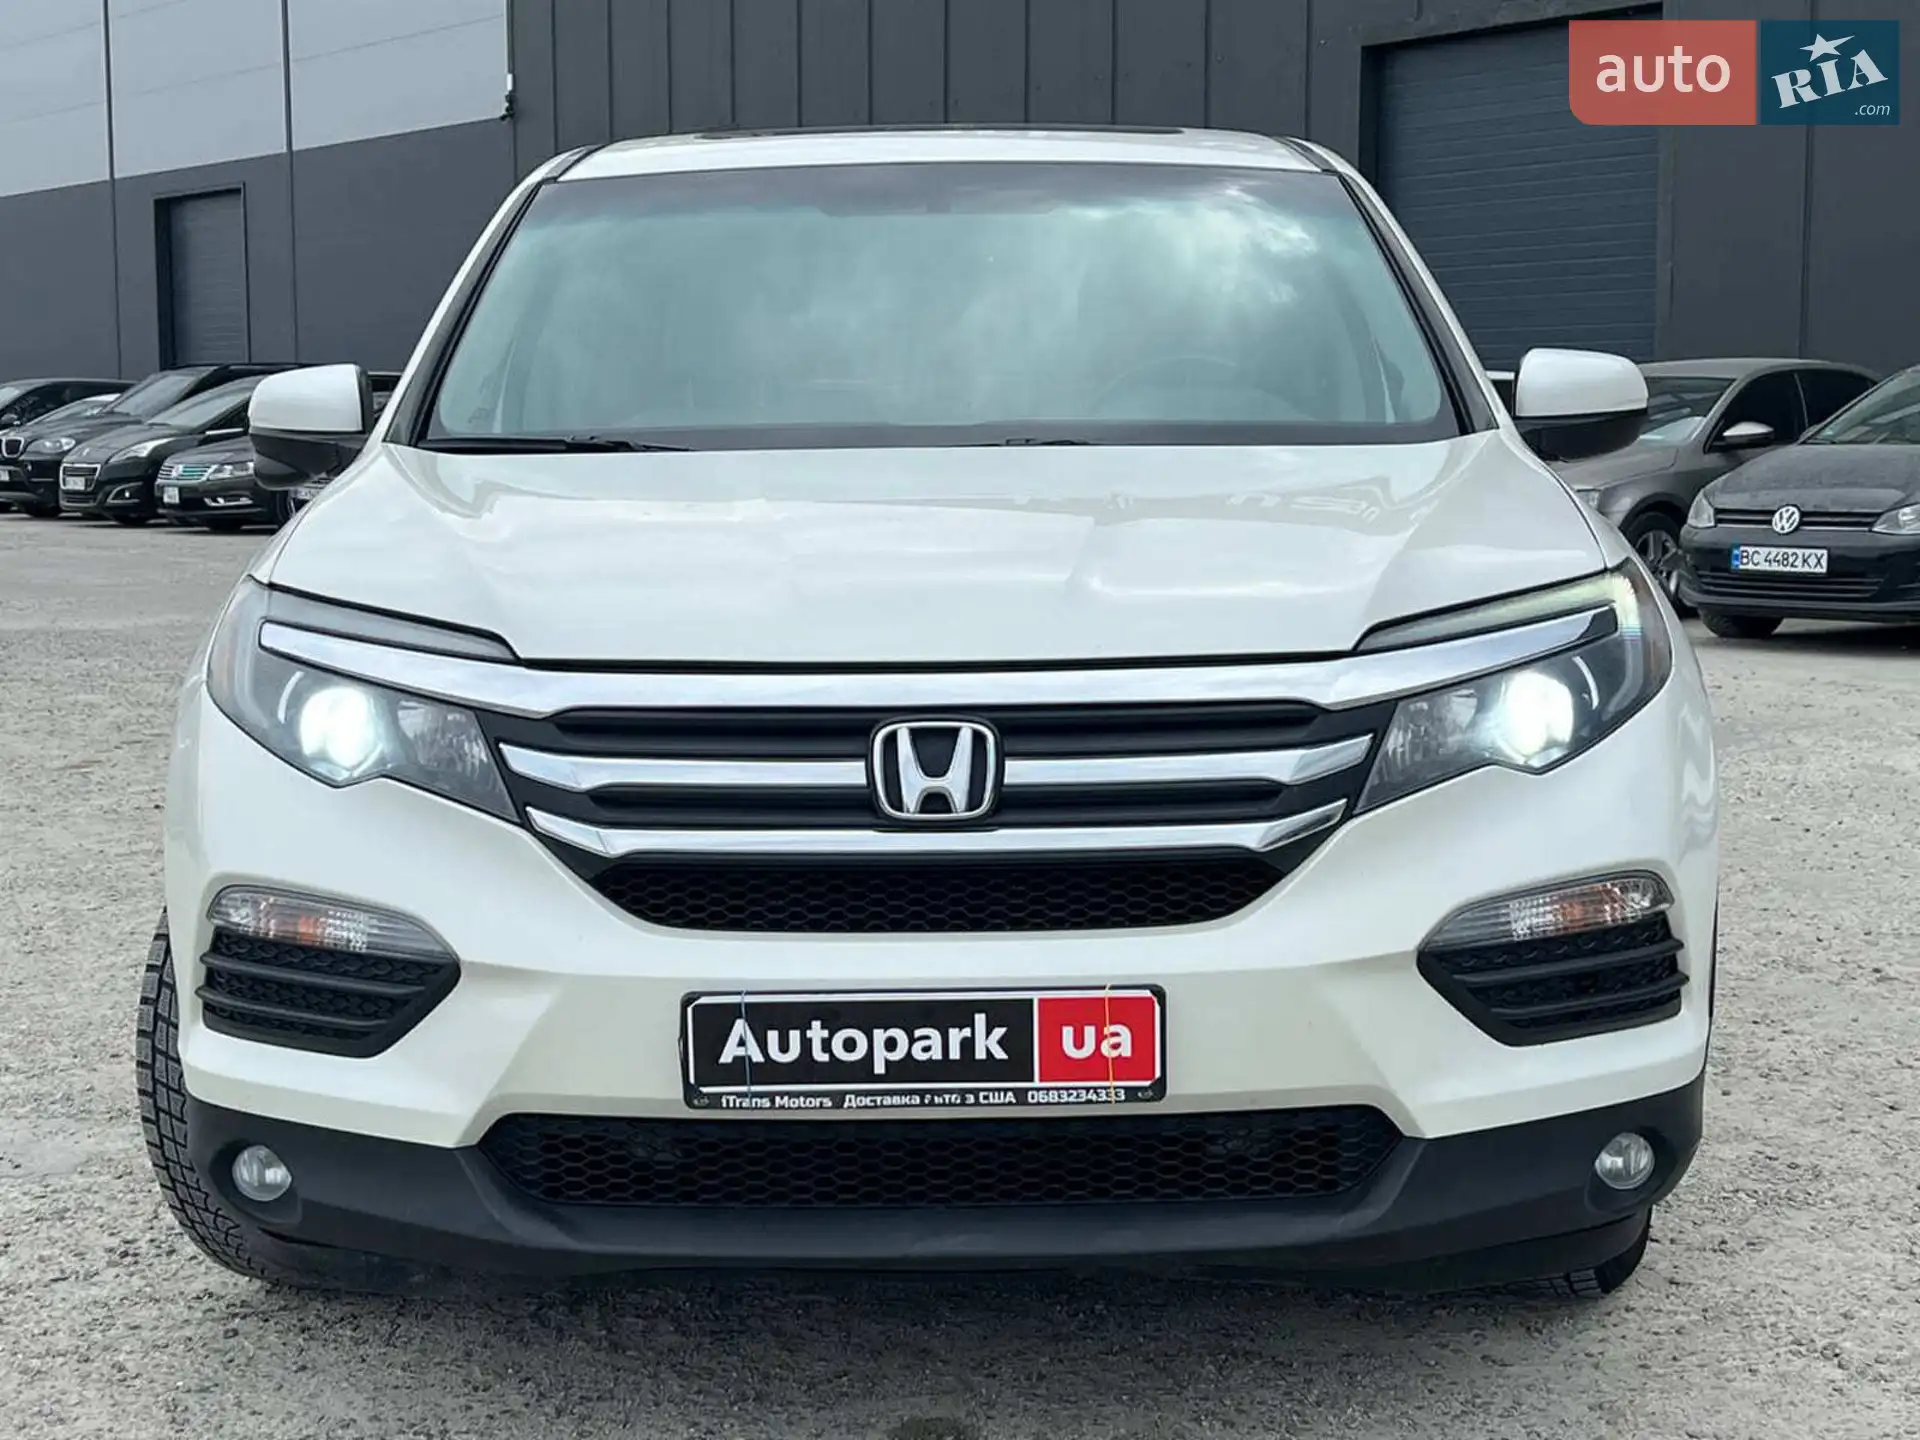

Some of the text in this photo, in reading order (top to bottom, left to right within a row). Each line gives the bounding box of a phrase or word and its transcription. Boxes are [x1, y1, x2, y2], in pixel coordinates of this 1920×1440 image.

[718, 1013, 1132, 1074] Autopark ua
[774, 1095, 832, 1108] Motors
[843, 1094, 920, 1109] Доставка
[978, 1091, 1017, 1105] США
